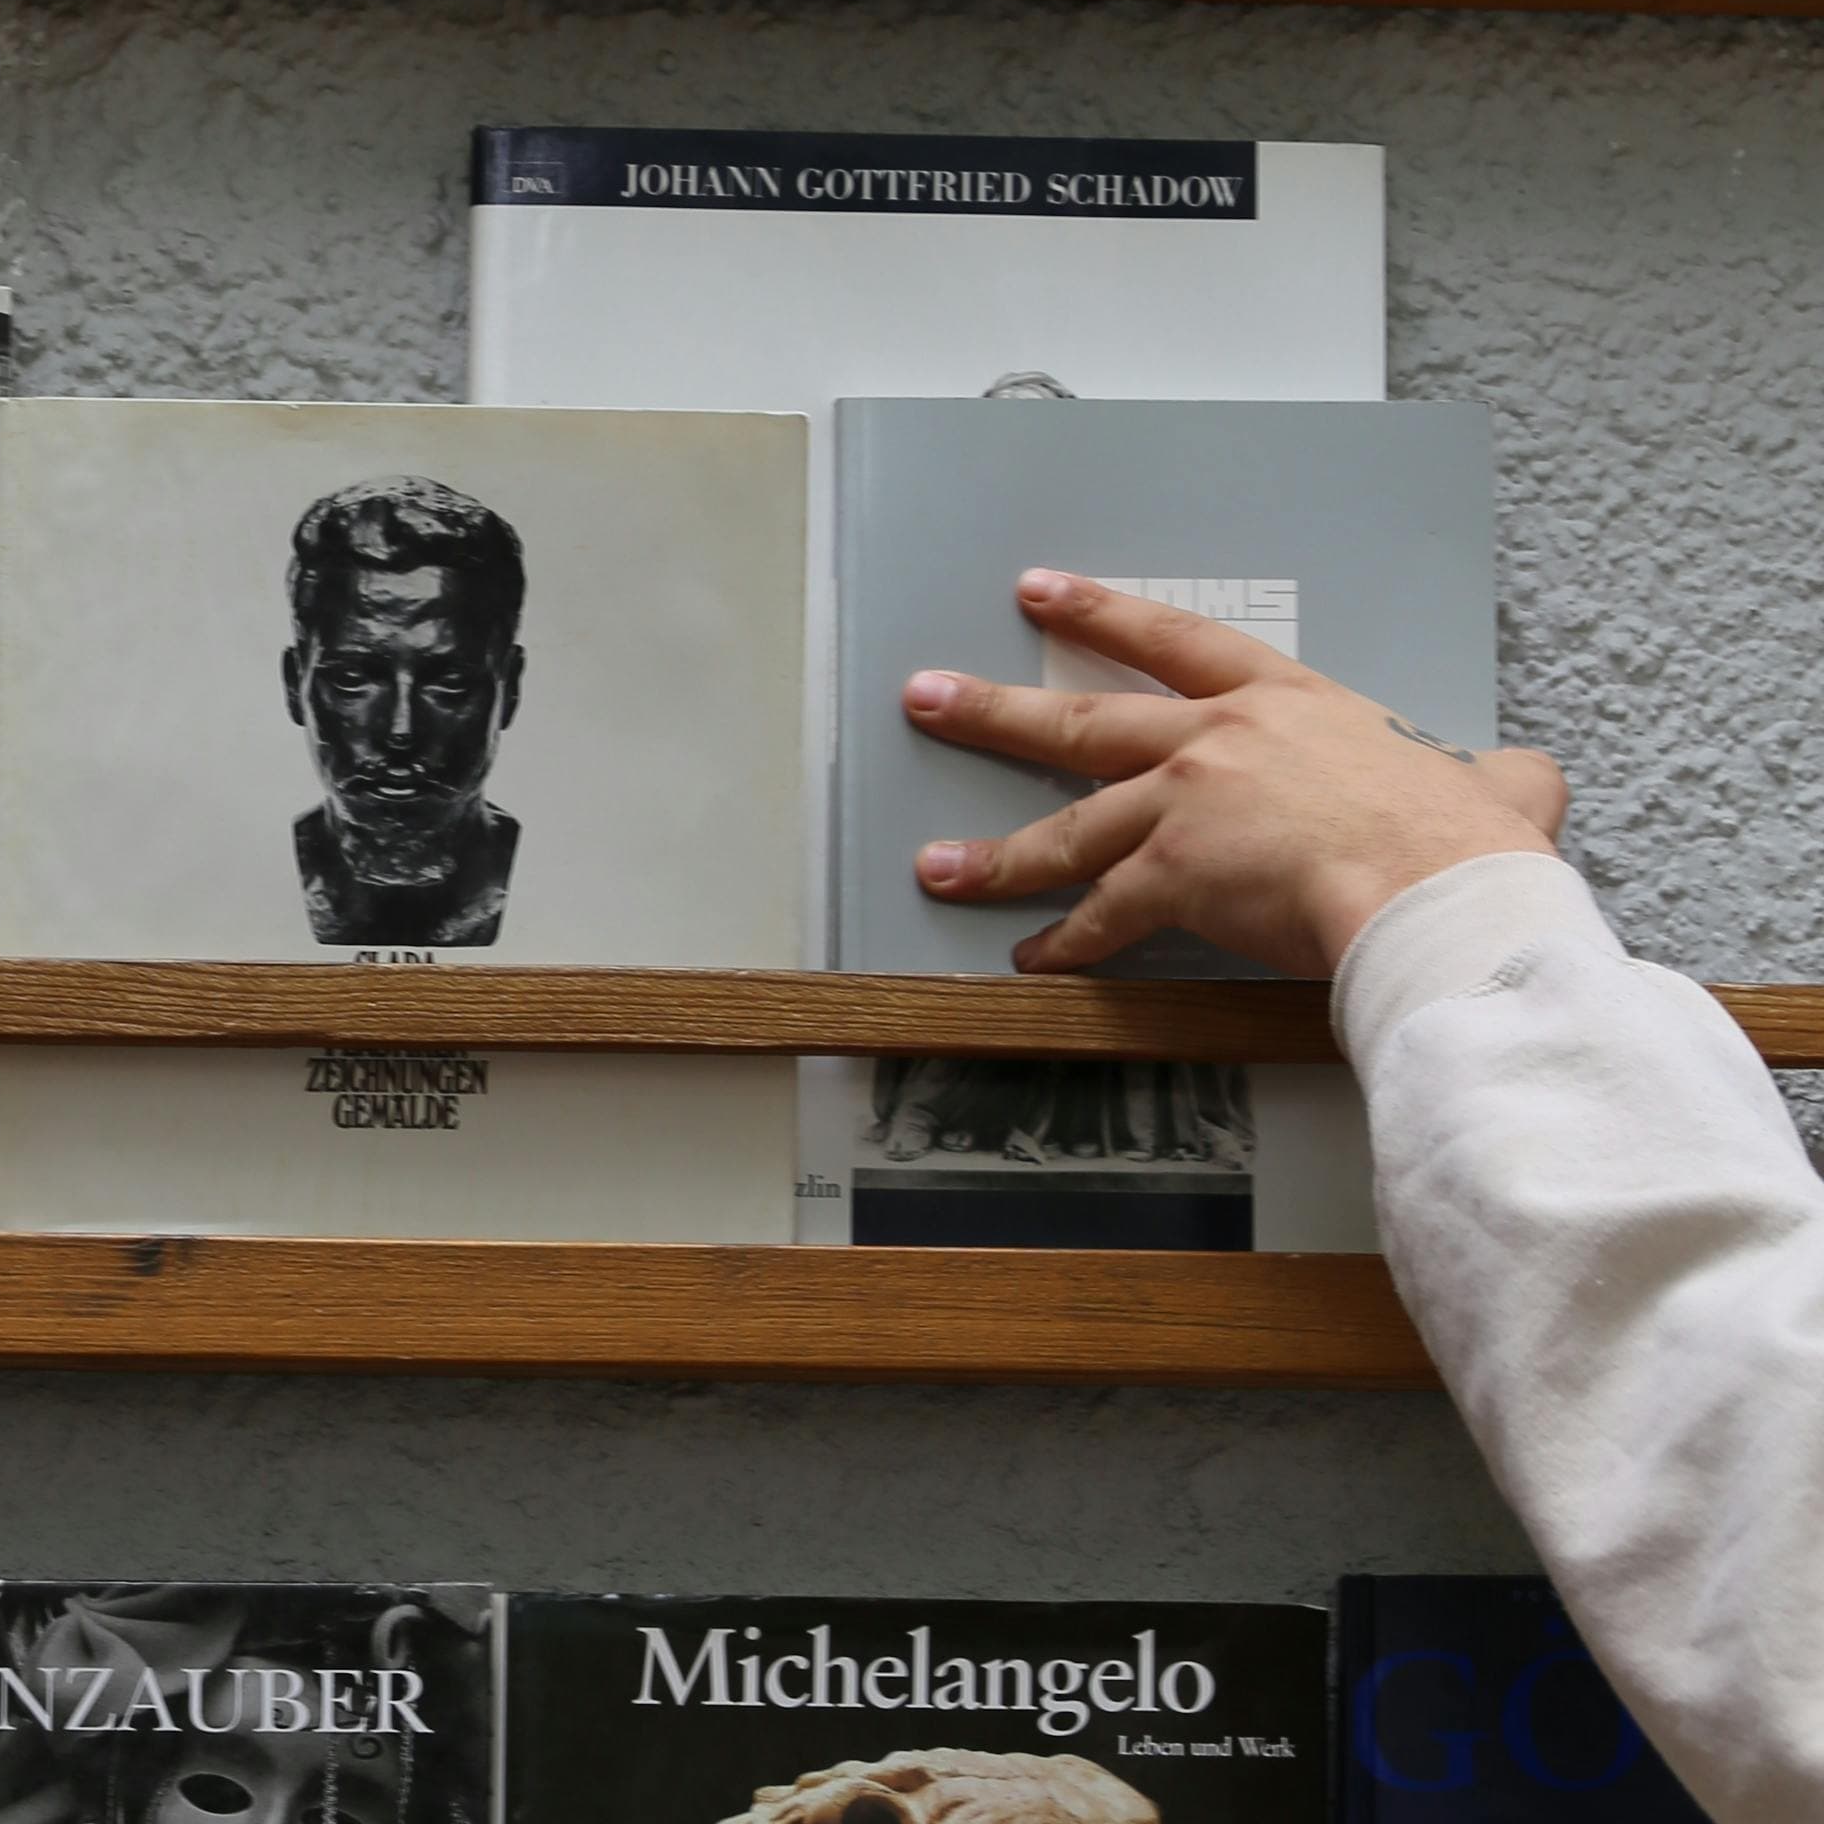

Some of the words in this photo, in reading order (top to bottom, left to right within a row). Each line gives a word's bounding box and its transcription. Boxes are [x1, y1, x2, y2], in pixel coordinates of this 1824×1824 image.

[511, 175, 556, 195] DVA
[620, 163, 780, 202] JOHANN
[796, 166, 1030, 206] GOTTFRIED
[1046, 172, 1243, 210] SCHADOW
[793, 1175, 841, 1200] zlin
[633, 1624, 1215, 1736] Michelangelo
[1118, 1736, 1184, 1757] Leben
[1190, 1737, 1232, 1758] und
[1238, 1738, 1295, 1759] Werk
